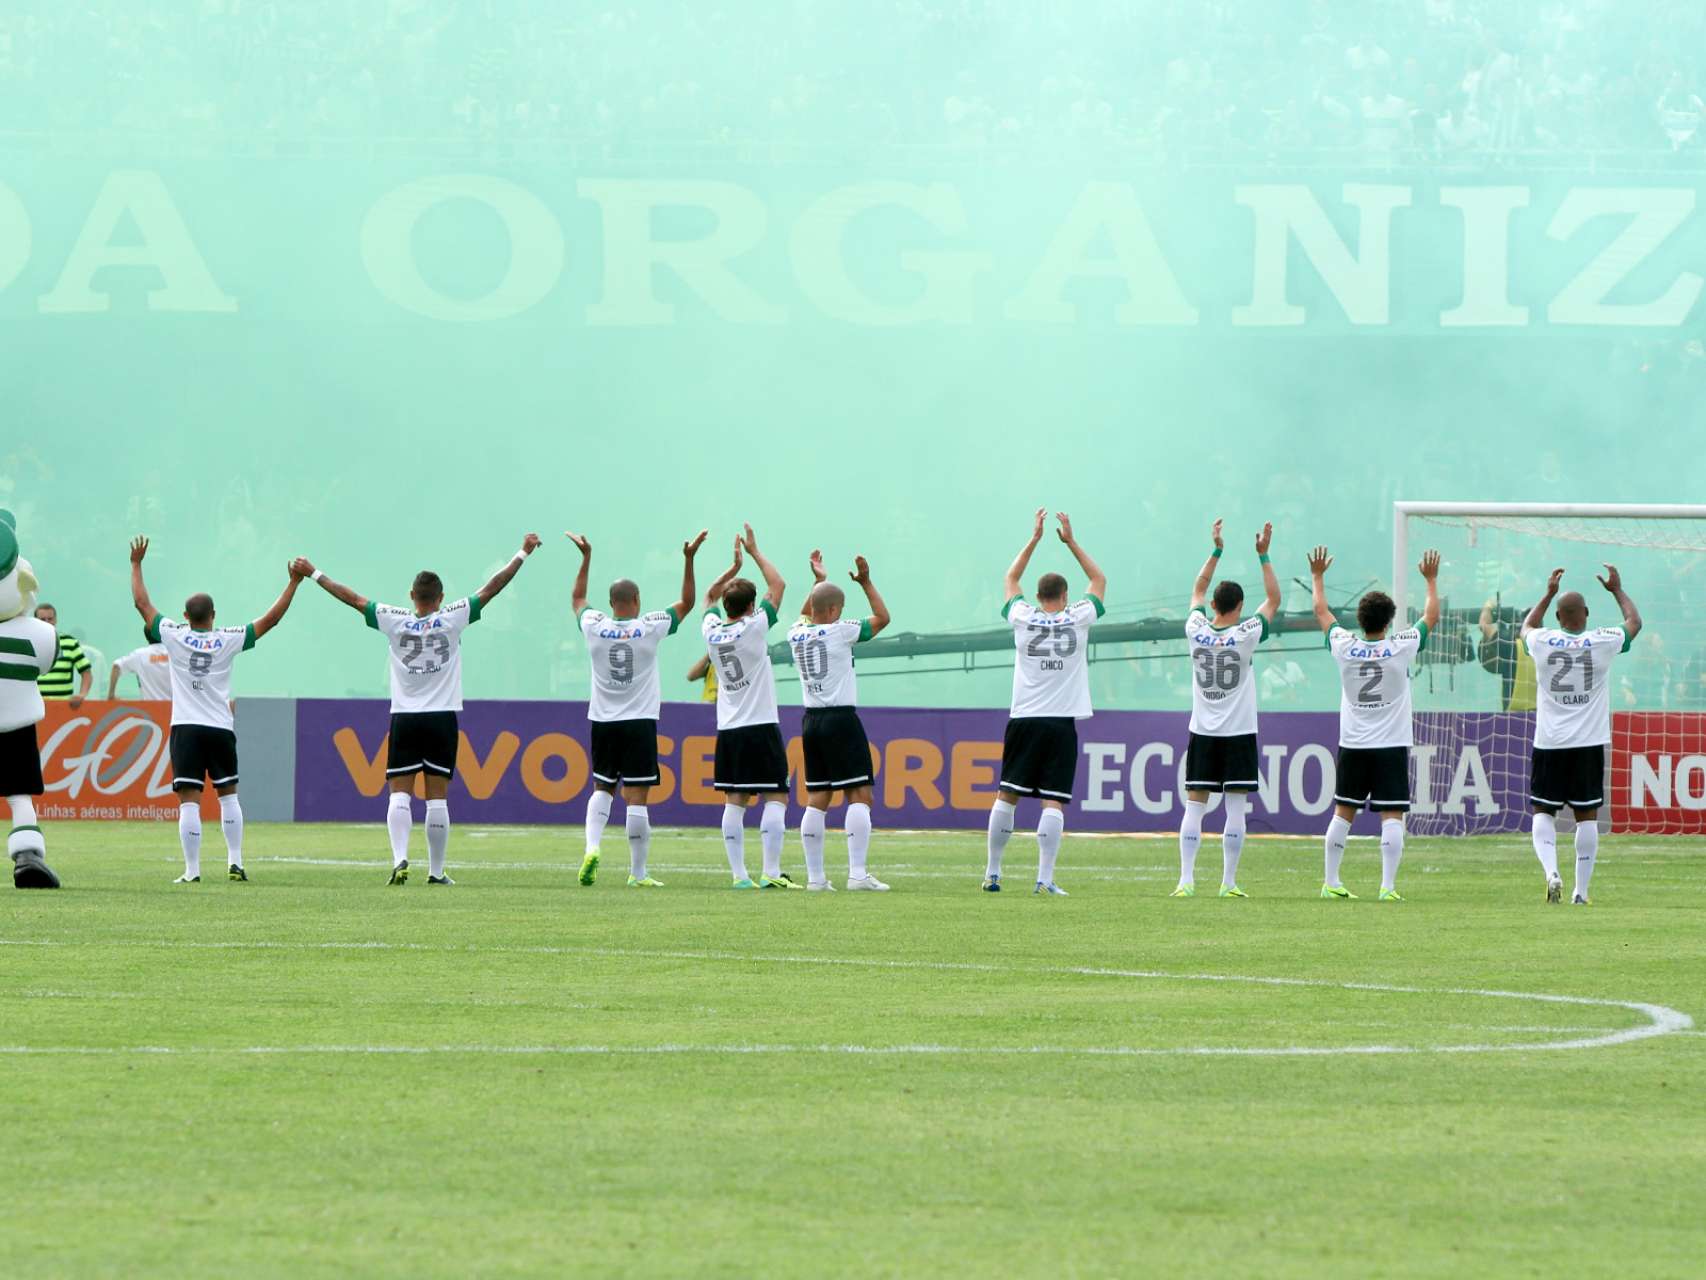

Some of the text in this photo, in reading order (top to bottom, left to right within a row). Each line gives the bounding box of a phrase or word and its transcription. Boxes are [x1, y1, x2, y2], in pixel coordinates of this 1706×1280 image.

[0, 169, 1704, 328] A ORGANIZ
[185, 636, 222, 649] CAIXA
[400, 632, 450, 671] 23
[600, 629, 641, 640] CAIXA
[1027, 622, 1077, 657] 25
[1195, 634, 1236, 647] CAIXA
[1549, 638, 1592, 648] CAIXA
[189, 652, 213, 677] 8
[609, 643, 634, 682] 9
[718, 645, 744, 683] 5
[794, 640, 828, 681] 10
[1040, 660, 1064, 671] CHICO
[1193, 647, 1241, 690] 36
[1350, 647, 1392, 658] CAIXA
[1357, 660, 1383, 702] 2
[1547, 649, 1593, 692] 21
[1562, 694, 1590, 705] CLARO
[333, 727, 589, 804] VVO
[36, 804, 76, 818] Linhas
[80, 804, 123, 819] aéreas
